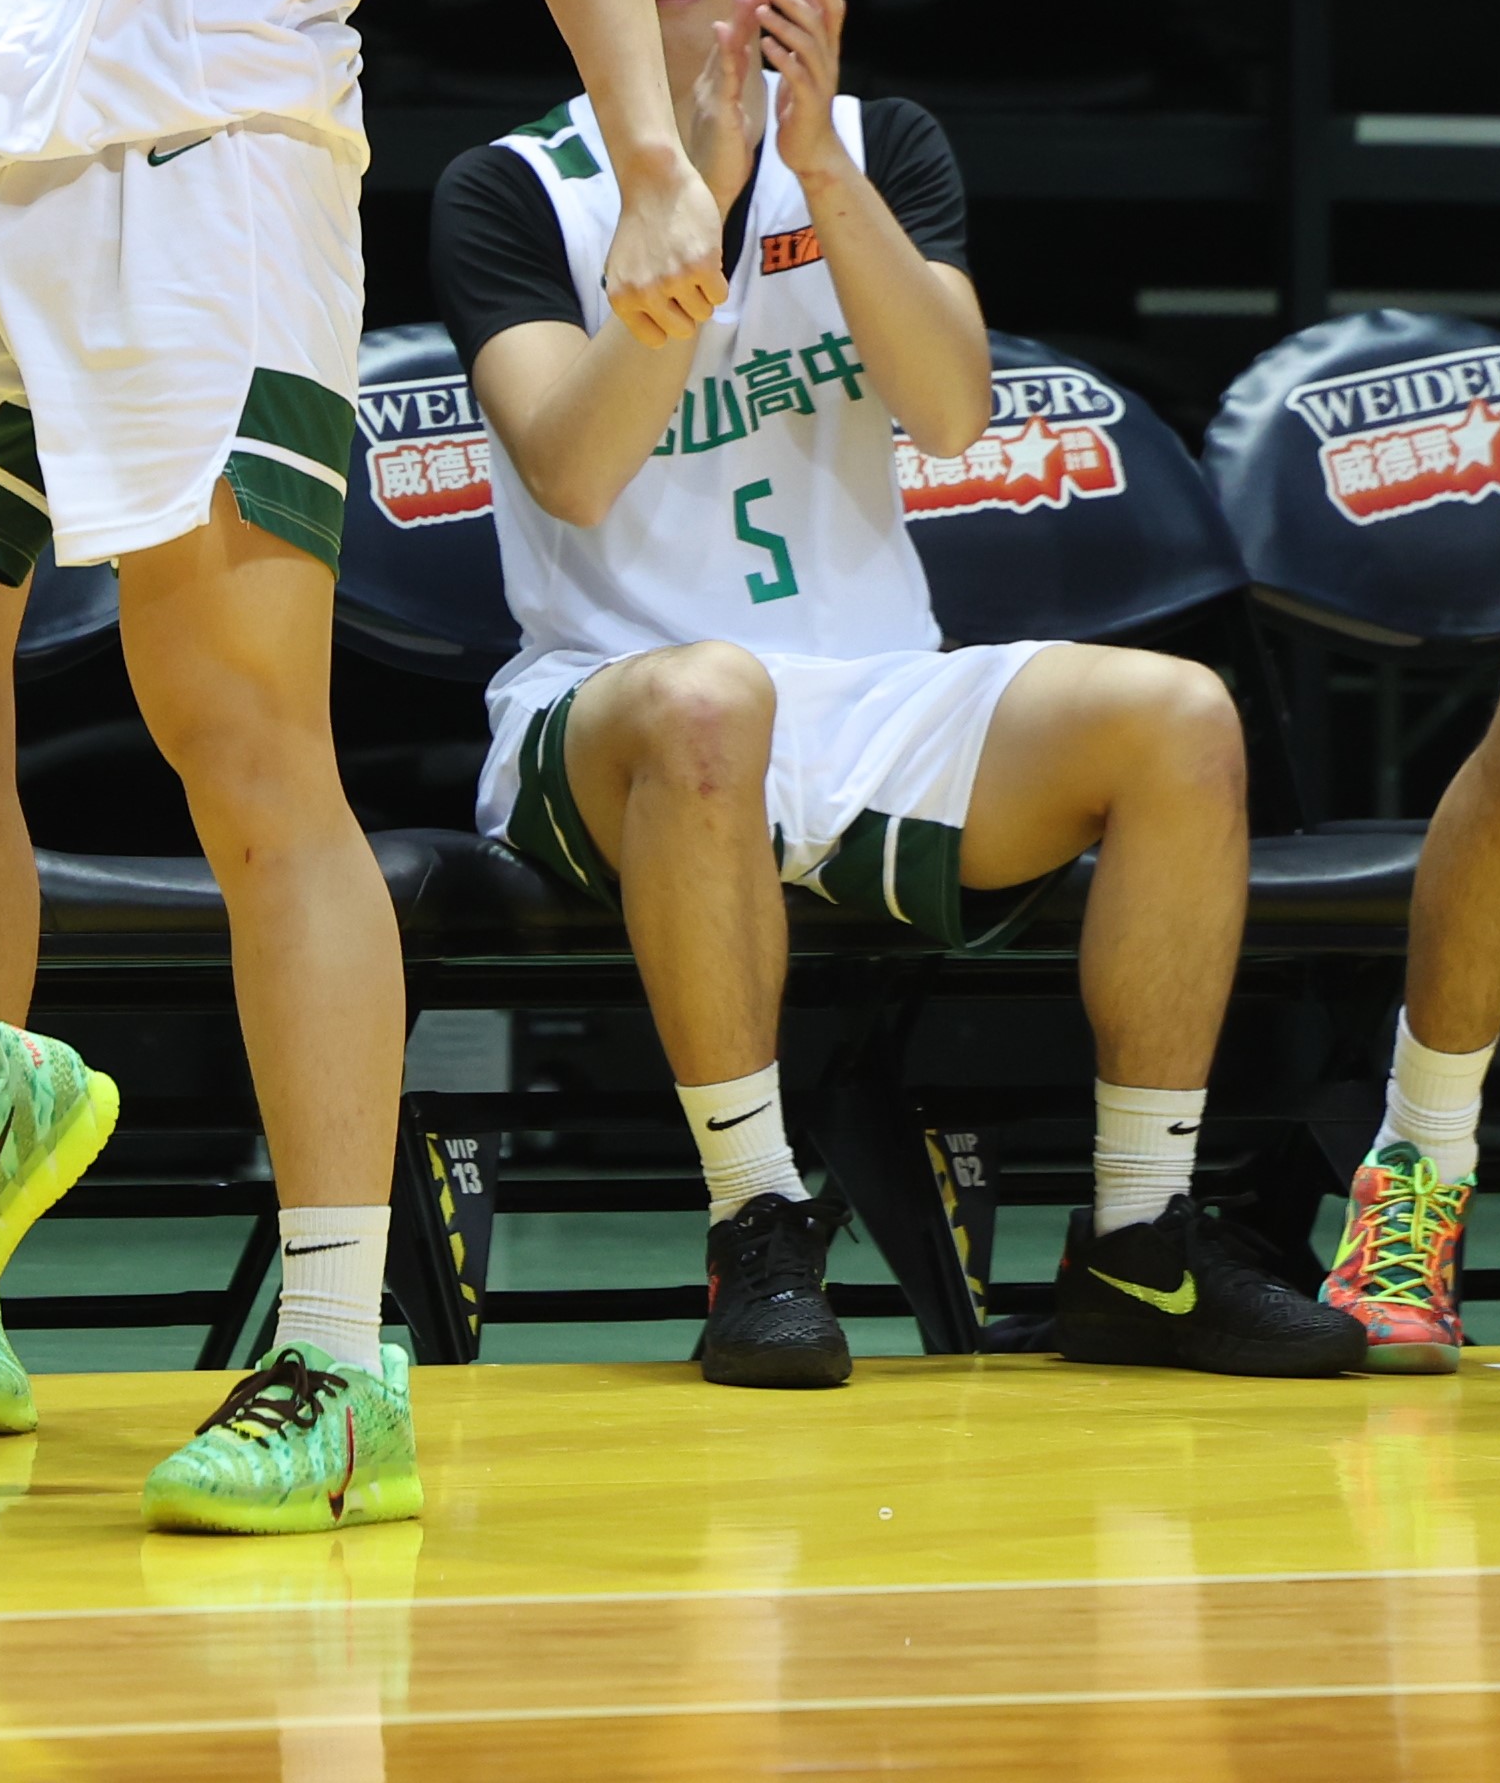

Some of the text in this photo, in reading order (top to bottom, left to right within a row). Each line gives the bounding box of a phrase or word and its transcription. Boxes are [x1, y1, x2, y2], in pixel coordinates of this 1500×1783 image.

[761, 226, 825, 276] HB
[732, 478, 799, 604] 5
[444, 1138, 480, 1159] VIP
[451, 1162, 484, 1194] 13
